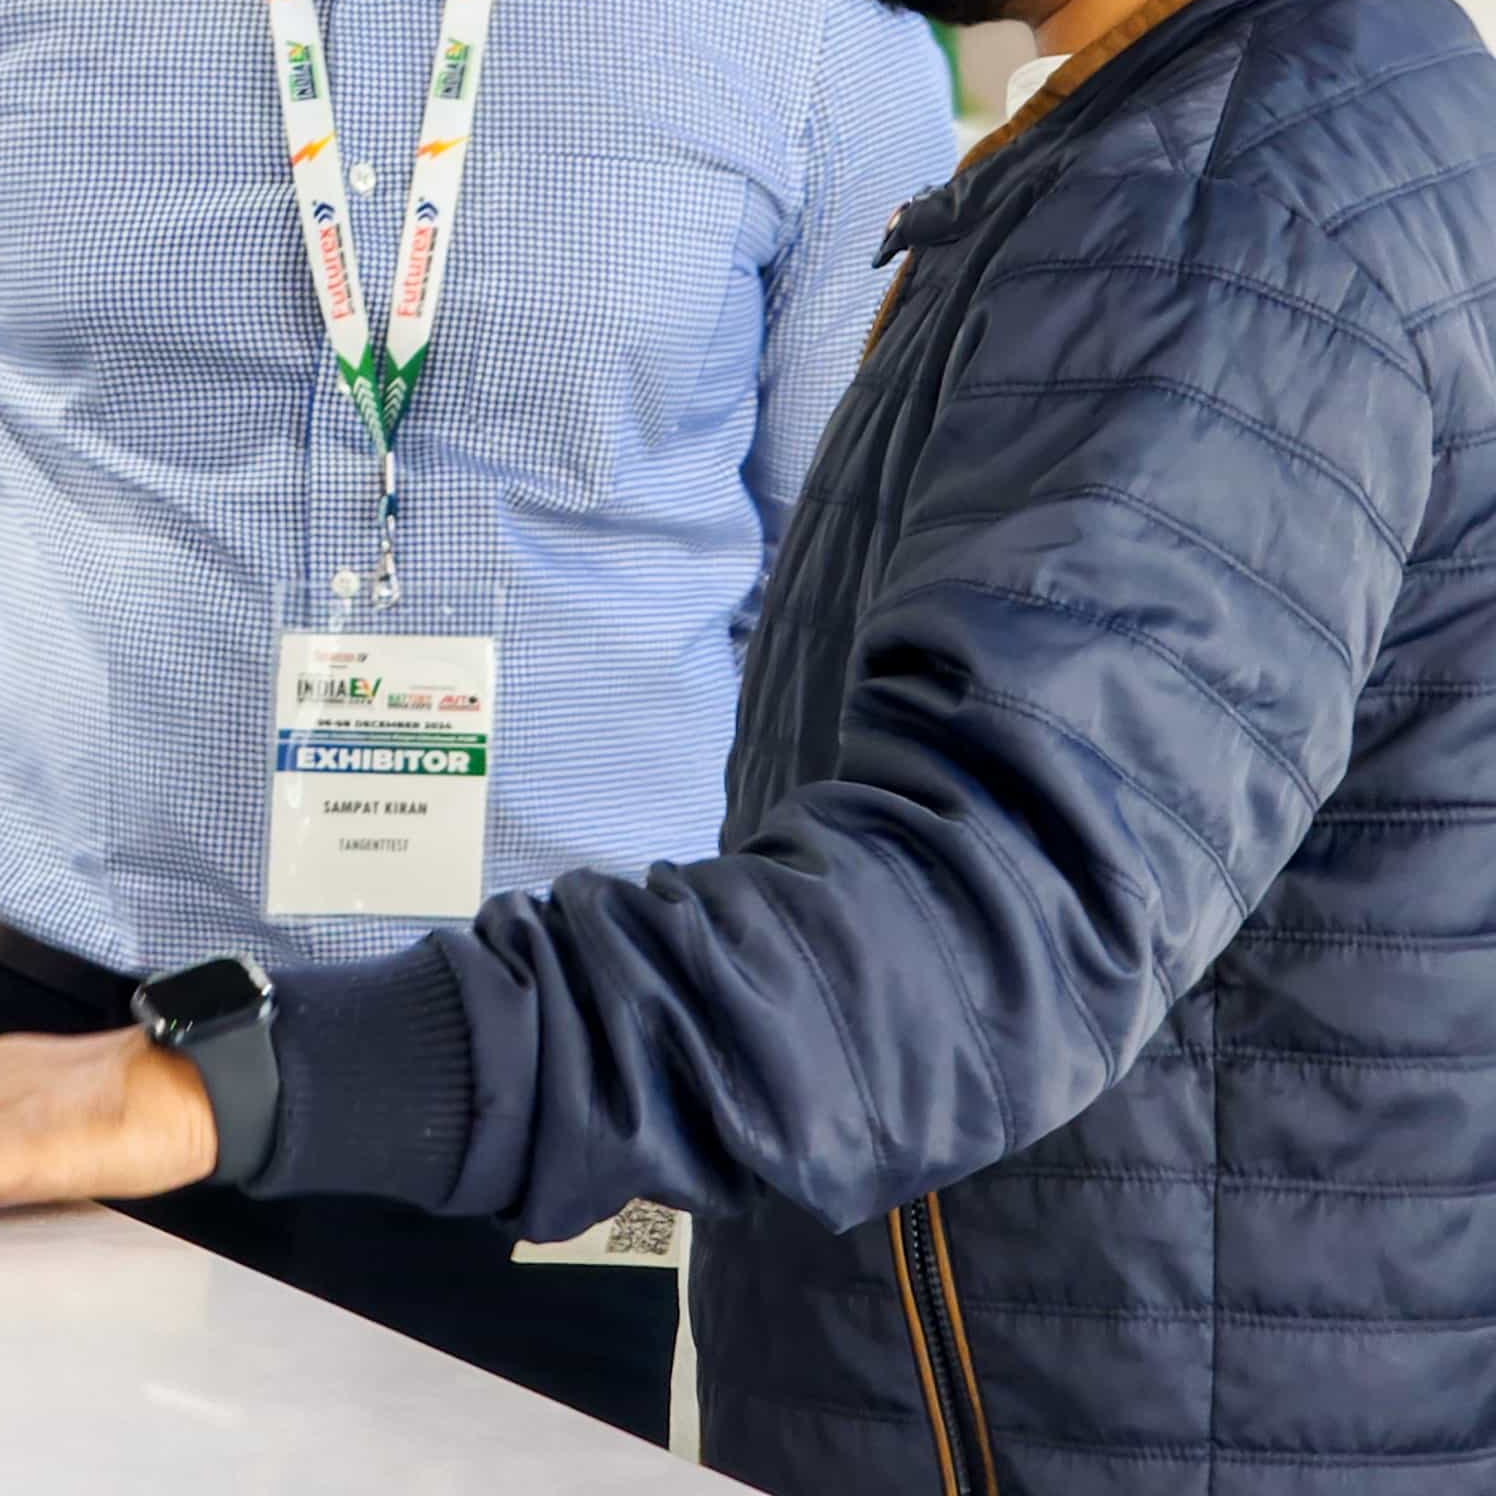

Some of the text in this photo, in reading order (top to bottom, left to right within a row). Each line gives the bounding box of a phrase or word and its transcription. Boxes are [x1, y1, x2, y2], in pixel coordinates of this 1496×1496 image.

[319, 226, 352, 320] Futurex
[397, 226, 433, 318] Futurex
[296, 746, 471, 773] EXHIBITOR
[323, 800, 428, 816] SAMPAT KIRAN
